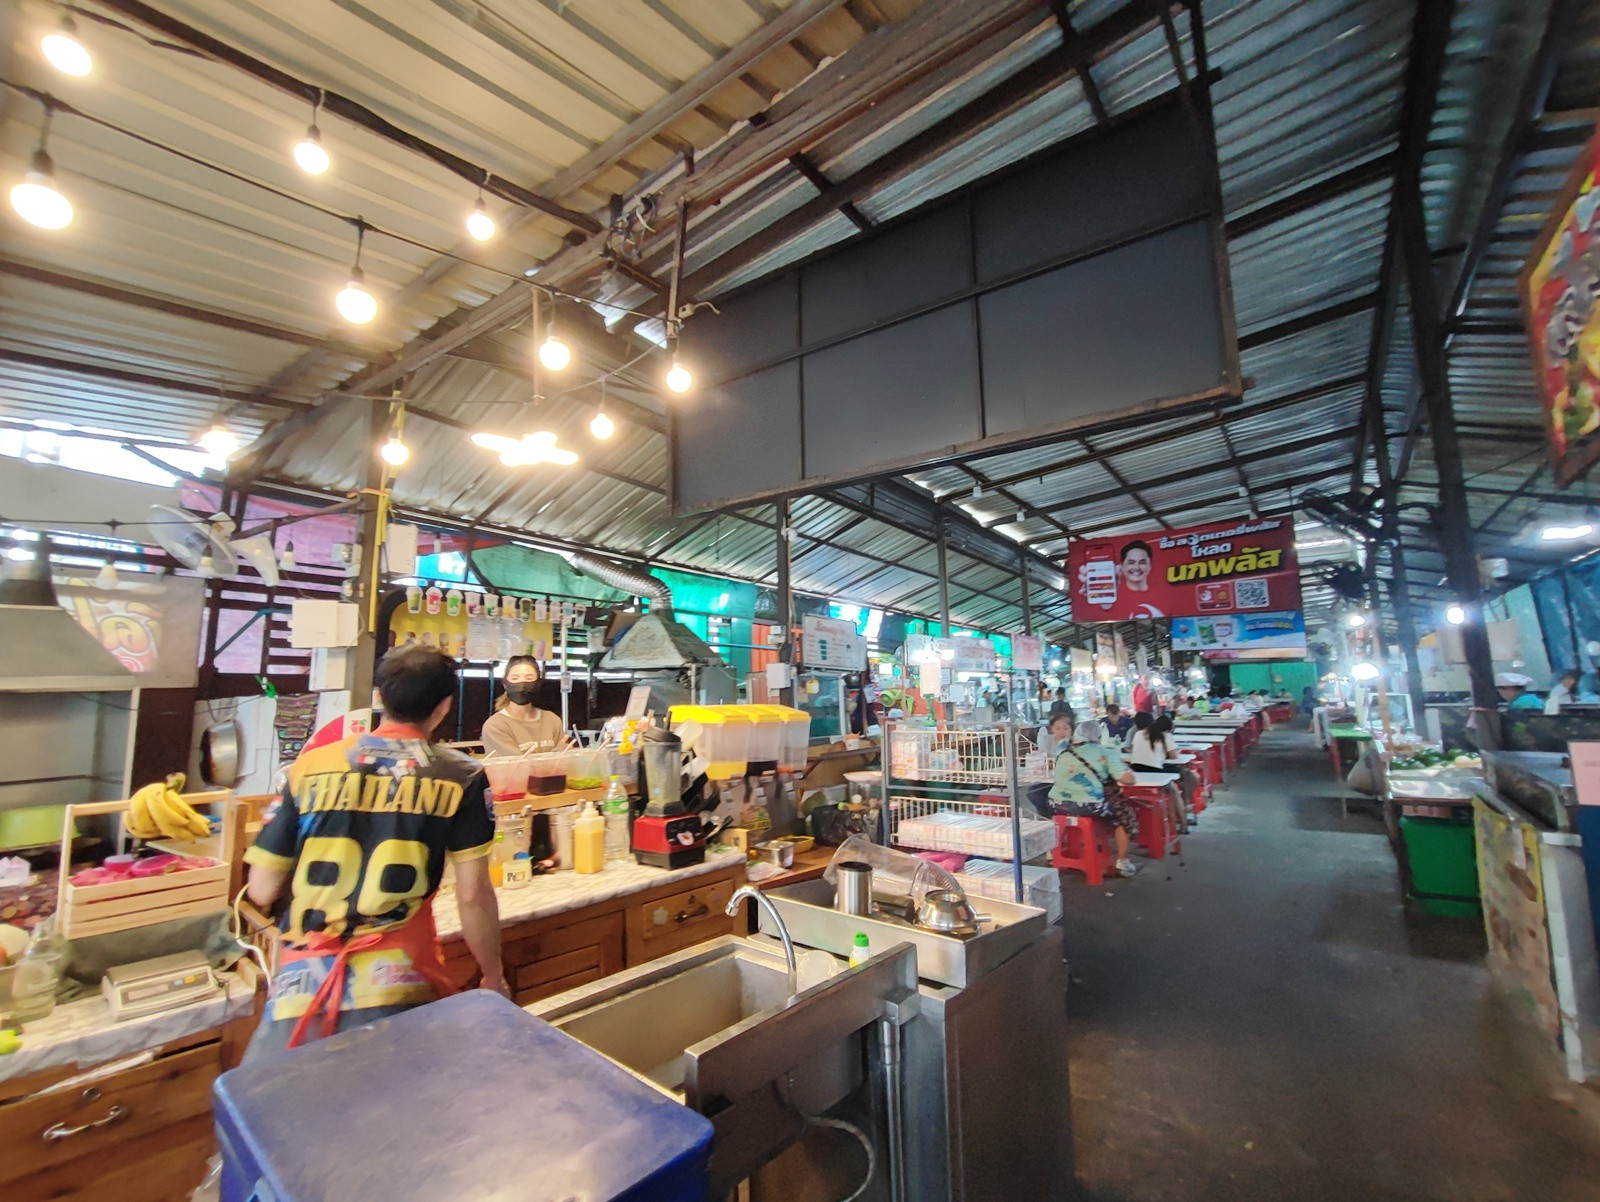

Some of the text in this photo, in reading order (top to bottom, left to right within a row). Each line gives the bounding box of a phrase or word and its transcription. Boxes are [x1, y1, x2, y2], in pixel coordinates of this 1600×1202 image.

[1167, 547, 1282, 582] นกพลัส
[298, 771, 465, 819] THAILAND
